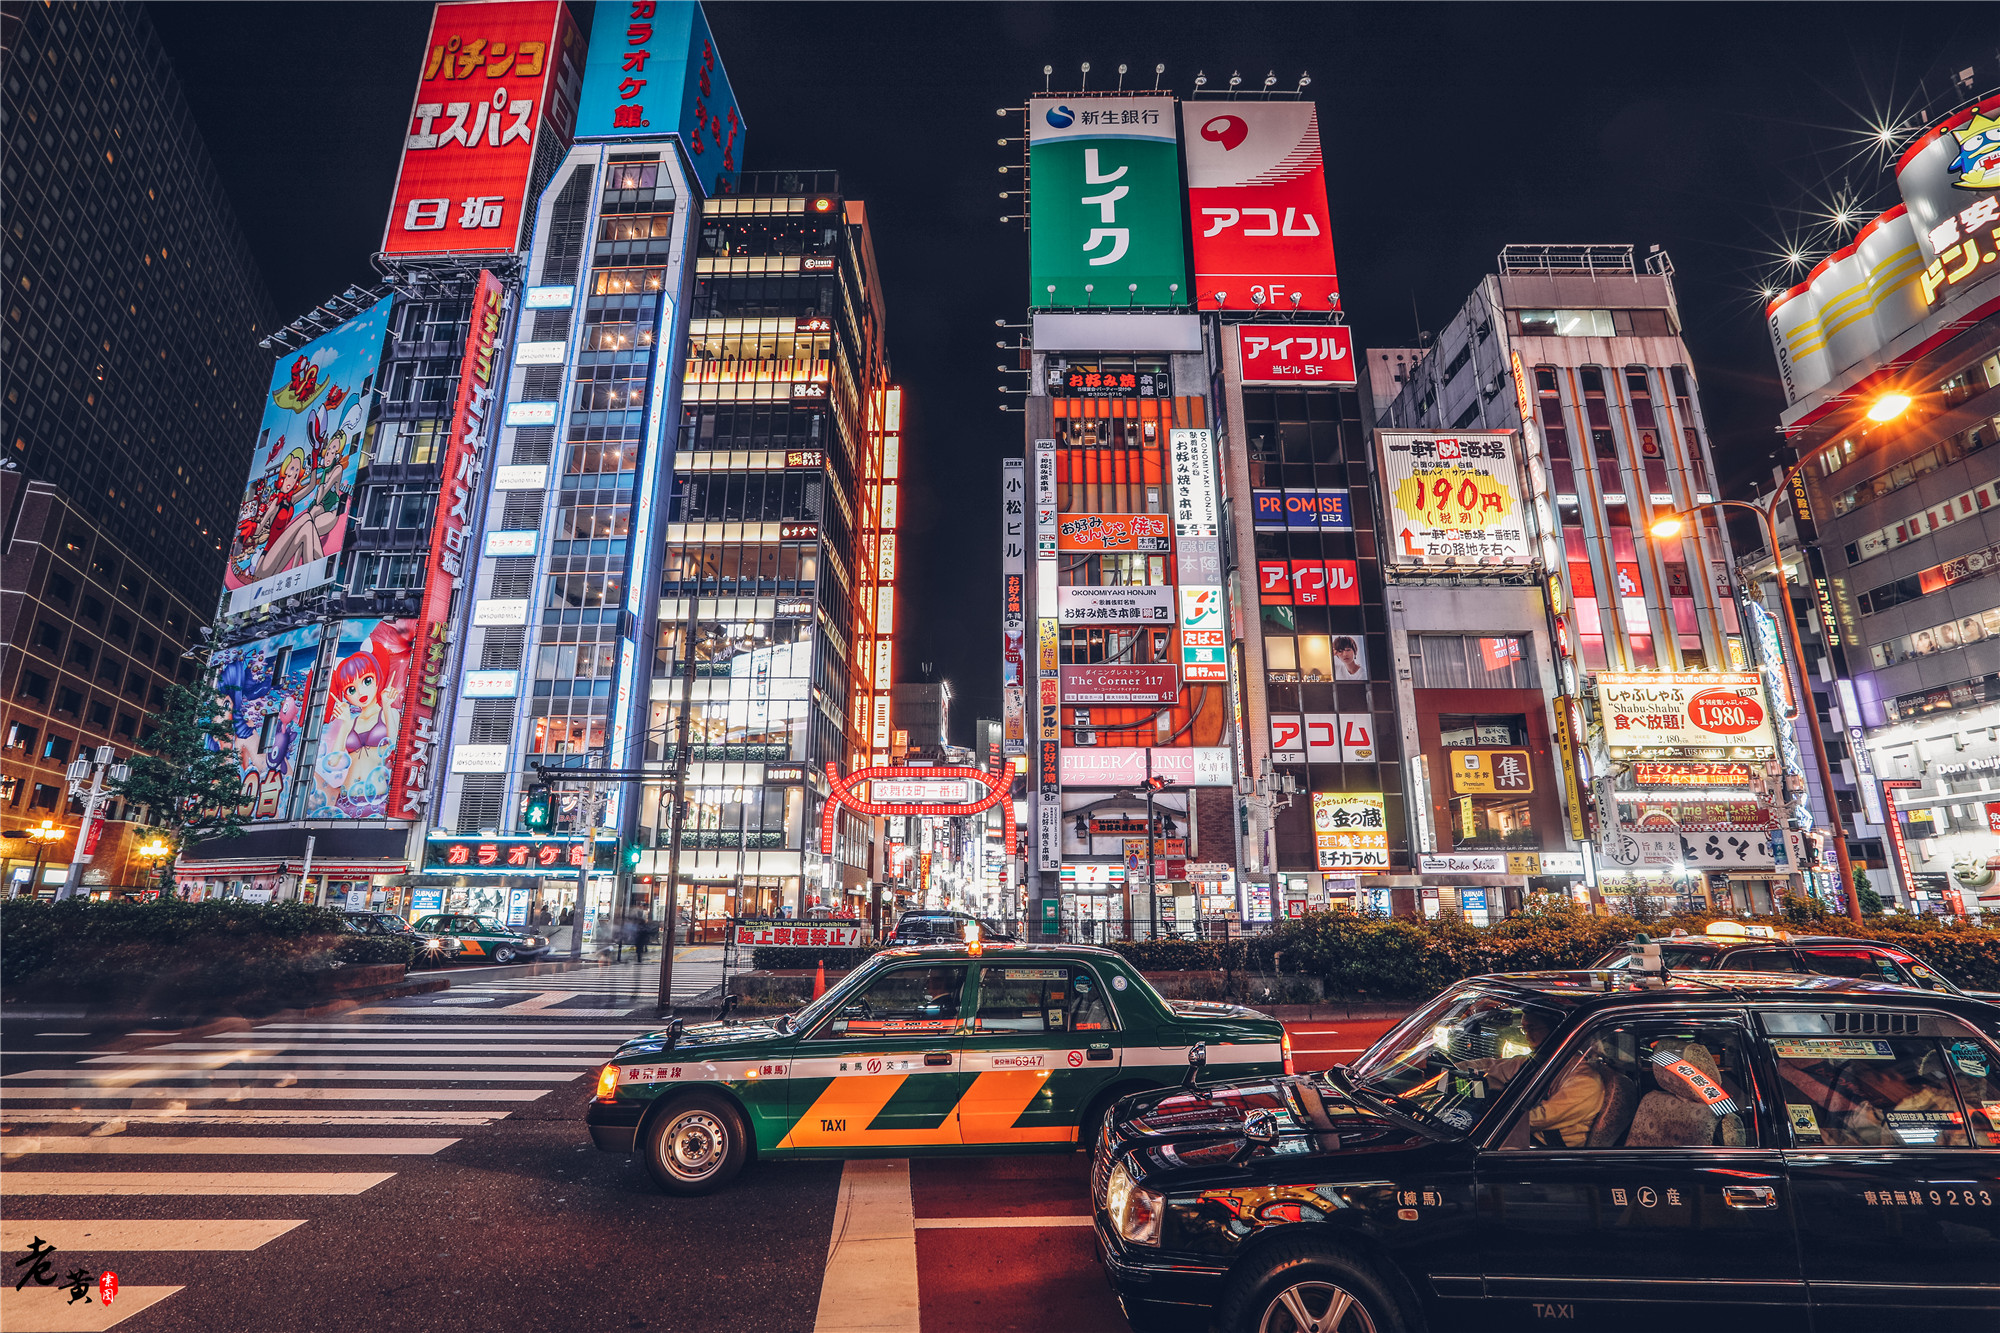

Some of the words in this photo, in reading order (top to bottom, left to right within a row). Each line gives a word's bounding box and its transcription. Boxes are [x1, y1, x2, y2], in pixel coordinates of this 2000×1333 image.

[424, 34, 546, 81] パチンコ
[613, 0, 657, 128] カラオケ館
[408, 88, 533, 150] エスパス
[1081, 109, 1160, 126] 新生銀行
[404, 196, 505, 231] 日拓
[1081, 148, 1130, 266] レイク
[1202, 207, 1320, 238] アコム
[1250, 285, 1286, 304] 3F
[475, 289, 504, 383] パチンコ
[1244, 337, 1347, 361] アイフル
[1771, 315, 1783, 341] Don
[1777, 348, 1796, 401] Quijote
[1272, 365, 1302, 376] 当ビル
[1304, 365, 1324, 376] 5F
[1069, 374, 1136, 388] お好み焼
[1158, 381, 1167, 389] 8F
[450, 383, 487, 524] エスパス
[1389, 439, 1506, 460] 一軒め酒場
[1200, 431, 1210, 488] OKONOMIYAKI
[1176, 441, 1193, 521] お好み焼き本陣
[1416, 477, 1504, 513] 190円
[1204, 490, 1213, 522] HONJIN
[1259, 497, 1343, 513] PROMISE
[1006, 477, 1022, 559] 小松ビル
[1061, 517, 1103, 535] お好み
[1130, 516, 1165, 535] 焼き
[1309, 513, 1343, 523] プロミス
[1427, 511, 1484, 525] (税別)
[791, 526, 817, 537] すずや
[1075, 521, 1125, 544] もんじゃ
[1419, 528, 1521, 541] 一軒め酒場一番街店
[490, 538, 532, 548] カラオケ館
[1102, 532, 1131, 548] たこ
[1158, 539, 1168, 549] 7F
[1427, 543, 1517, 556] 左の路地を右へ
[1180, 556, 1219, 573] 本陣
[1262, 566, 1354, 589] アイフル
[1008, 576, 1021, 612] お好み焼
[1302, 593, 1317, 602] 5F
[1064, 608, 1141, 619] お好み焼き本陣
[1155, 608, 1168, 617] 2F
[1185, 631, 1223, 645] たばこ
[1196, 648, 1213, 662] 酒
[420, 621, 449, 707] パチンコ
[1069, 676, 1093, 685] The
[1098, 676, 1140, 685] Corner
[1144, 676, 1163, 685] 117
[1186, 667, 1224, 678] 銀行ATM
[1601, 675, 1673, 684] All-you-can-eat
[1675, 675, 1704, 684] buffet
[1706, 675, 1720, 684] for
[1730, 676, 1758, 684] hours
[468, 679, 513, 688] カラオケ館
[1161, 691, 1174, 700] 4F
[1606, 688, 1685, 702] しゃぶしゃぶ
[1041, 680, 1057, 727] 麻雀フル
[1613, 714, 1686, 731] 食べ放題!
[1698, 707, 1746, 729] 1,980
[1746, 718, 1759, 726] yen
[1044, 729, 1055, 737] 6F
[1271, 721, 1372, 748] アコム
[1202, 752, 1225, 761] 美容
[1281, 753, 1295, 762] 3F
[1755, 747, 1774, 758] 5F
[403, 717, 432, 815] エスパス
[1043, 742, 1056, 784] お好み焼
[1062, 755, 1123, 769] FILLER
[1135, 755, 1193, 769] CLINIC
[1198, 763, 1230, 772] 皮膚科
[1637, 765, 1652, 774] 7F
[1656, 765, 1747, 774] ひょうたん
[1936, 762, 1966, 775] Don
[1967, 754, 2000, 770] Quij
[1062, 773, 1097, 782] フィラー
[1099, 772, 1143, 782] クリニック
[1208, 773, 1220, 783] 3F
[1496, 757, 1527, 787] 集
[876, 784, 964, 798] 歌舞伎町一番街
[1044, 794, 1056, 802] 8F
[1332, 807, 1383, 828] 金の蔵
[1338, 834, 1387, 848] 焼き牛丼
[1328, 851, 1387, 866] チカラめし
[1448, 859, 1470, 871] Roko
[1472, 858, 1496, 871] Shira
[1524, 855, 1538, 872] 集
[839, 1061, 863, 1072] 練馬
[1015, 1056, 1043, 1066] 6947
[628, 1067, 682, 1080] 東京無線
[757, 1064, 788, 1077] (練馬)
[820, 1118, 847, 1132] TAXI
[1397, 1190, 1443, 1207] (練馬)
[1611, 1188, 1628, 1206] 国
[1667, 1187, 1682, 1206] 産
[1864, 1190, 1924, 1206] 東京無線
[1929, 1190, 1993, 1206] 9283
[1532, 1303, 1575, 1319] TAXI
